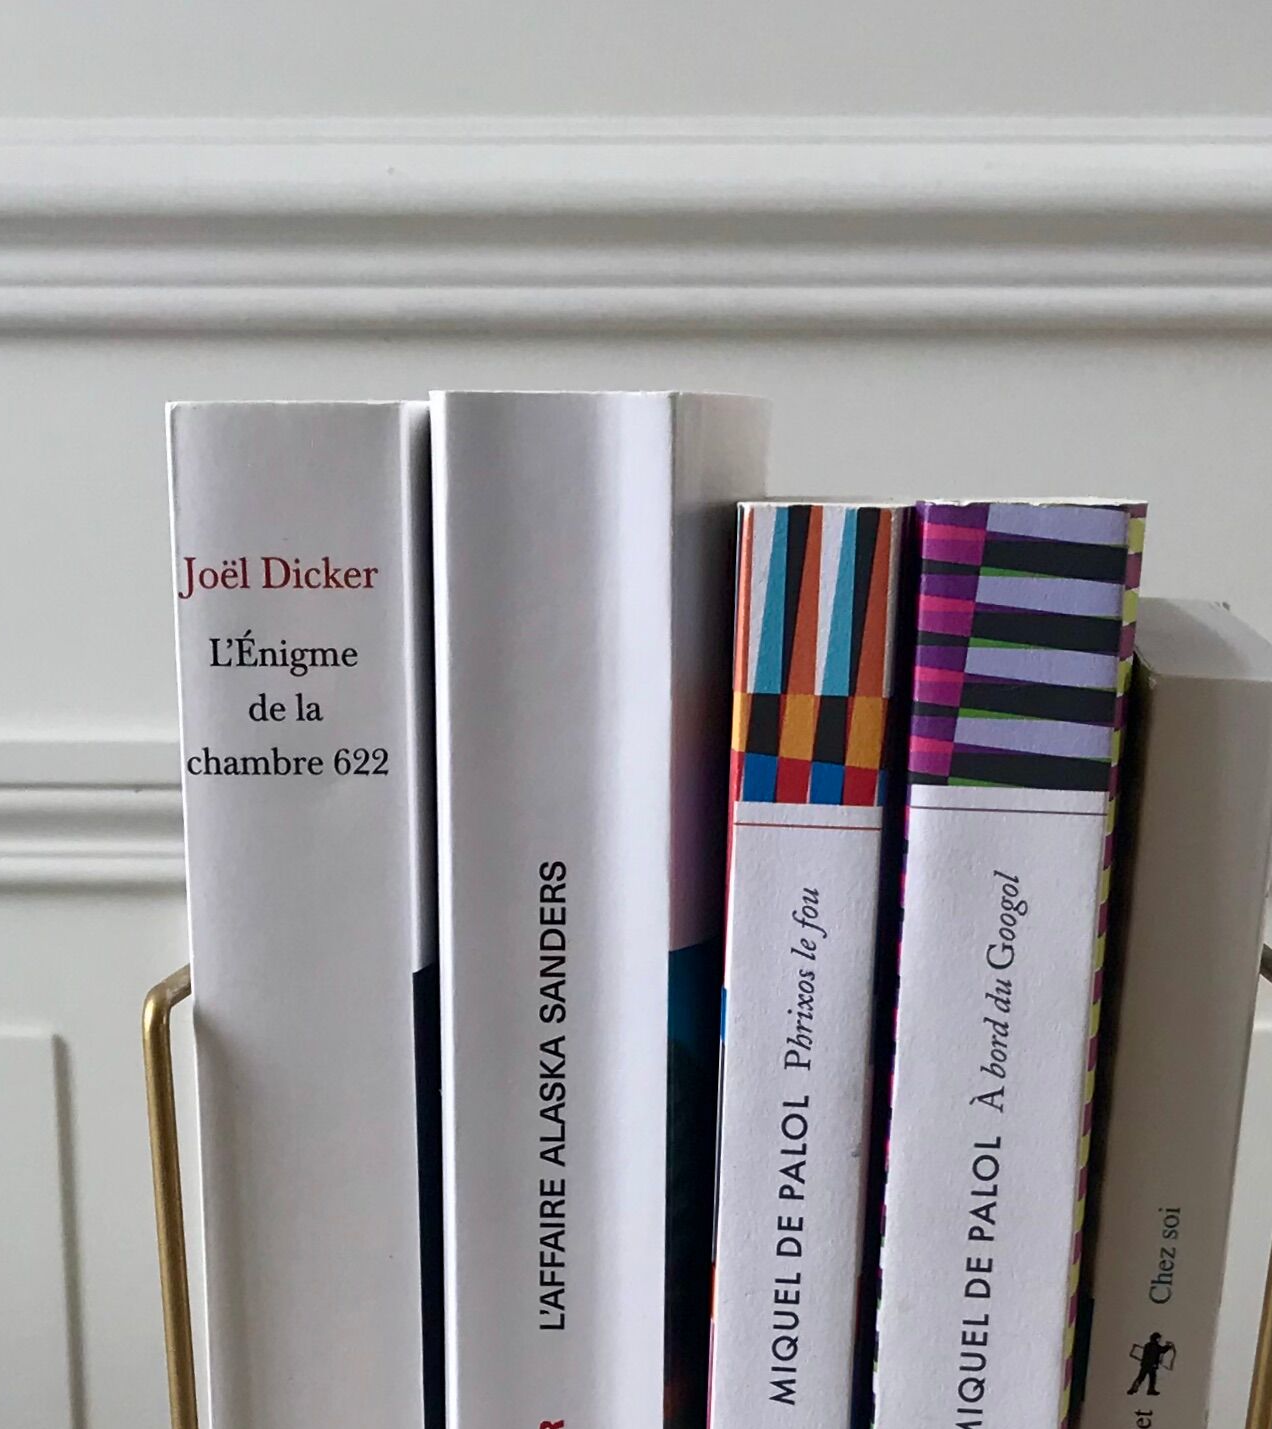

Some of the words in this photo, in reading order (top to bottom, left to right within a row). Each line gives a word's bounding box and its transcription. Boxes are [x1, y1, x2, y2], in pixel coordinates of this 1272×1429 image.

[178, 556, 250, 599] Joël
[260, 556, 378, 589] Dicker
[248, 693, 286, 722] de
[295, 693, 323, 722] la
[186, 747, 323, 776] chambre
[333, 747, 389, 776] 622
[792, 886, 828, 938] fou
[986, 870, 1028, 969] Googol
[539, 860, 567, 1023] SANDERS
[790, 937, 817, 961] le
[783, 968, 817, 1071] Phrixos
[985, 979, 1013, 1013] du
[980, 1018, 1011, 1077] bord
[539, 1035, 567, 1167] ALASKA
[969, 1085, 1005, 1113] À
[779, 1094, 810, 1201] PALOL
[969, 1135, 1001, 1241] PALOL
[776, 1215, 804, 1258] DE
[1158, 1206, 1182, 1240] soi
[965, 1257, 994, 1299] DE
[1148, 1247, 1176, 1304] Chez
[769, 1271, 801, 1406] MIQUEL
